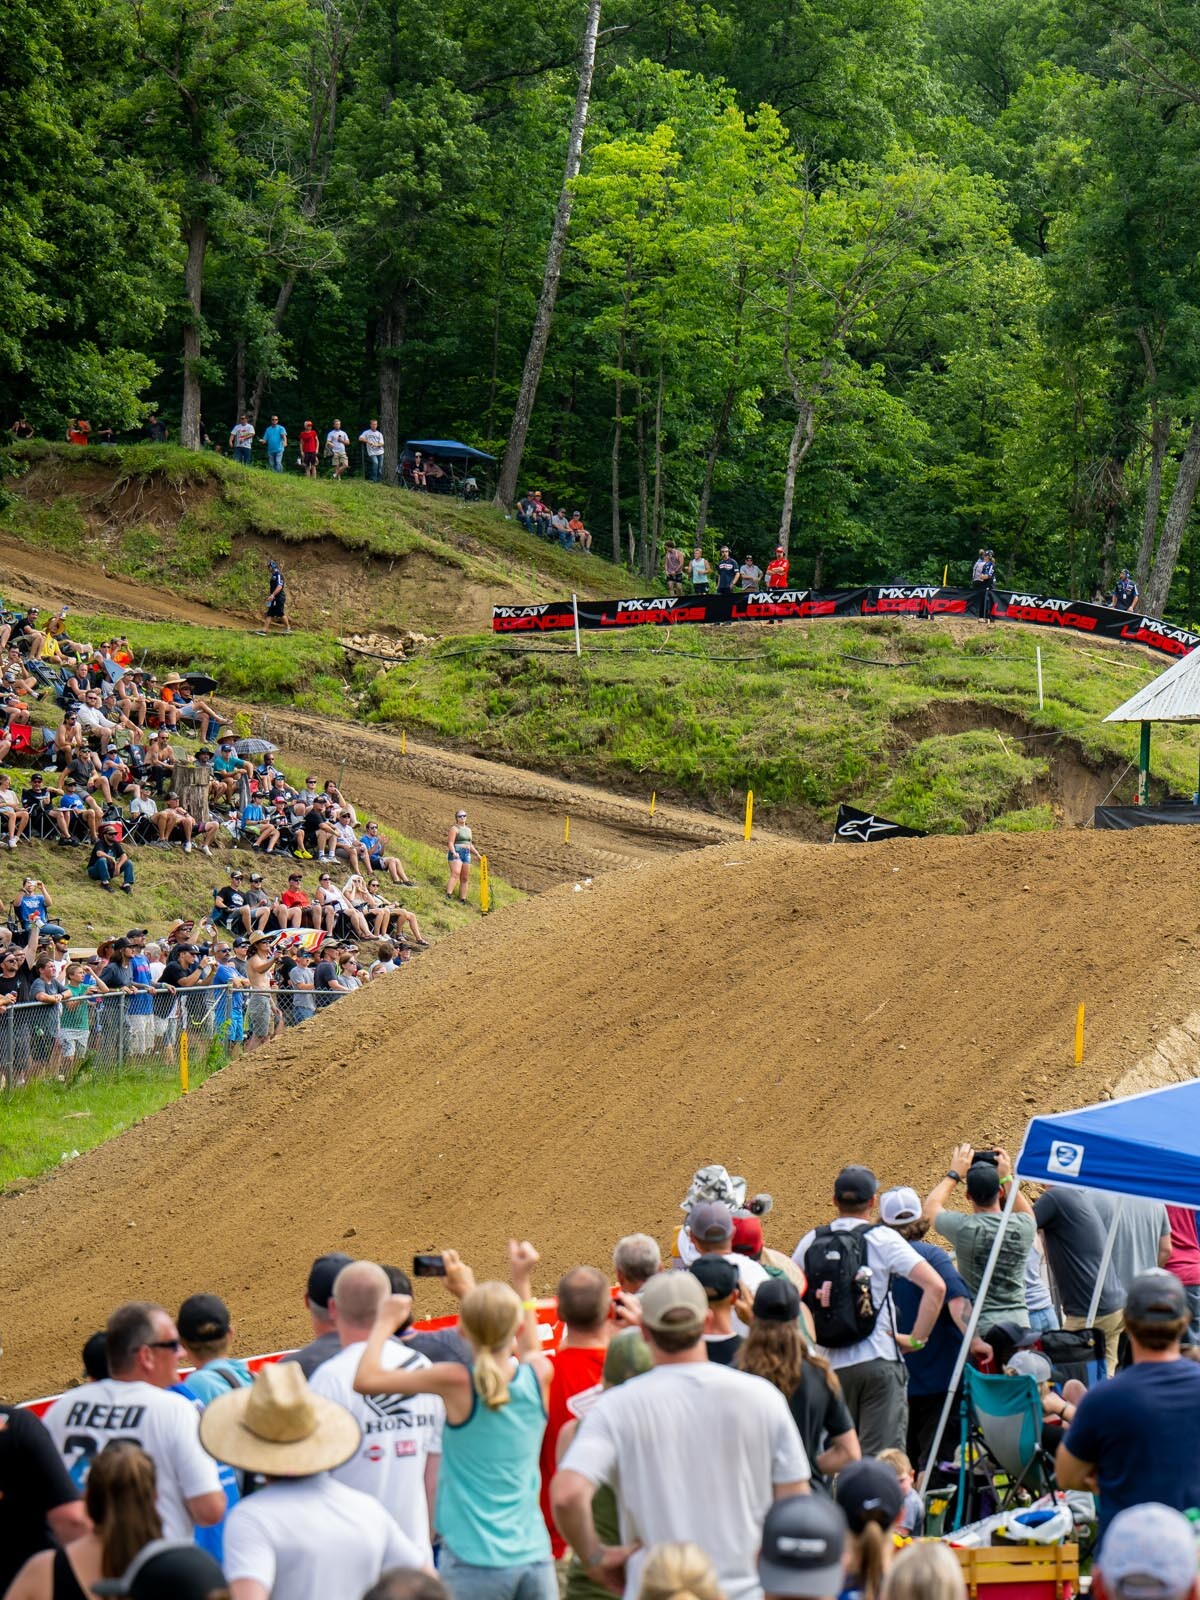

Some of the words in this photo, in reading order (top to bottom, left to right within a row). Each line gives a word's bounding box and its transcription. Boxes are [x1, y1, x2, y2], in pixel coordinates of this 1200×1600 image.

[747, 593, 773, 604] MX
[777, 591, 809, 603] ATV
[878, 588, 906, 599] MX
[909, 587, 941, 598] ATV
[493, 606, 517, 618] MX
[520, 604, 550, 617] ATV
[618, 599, 643, 612] MX
[648, 598, 679, 610] ATV
[1009, 594, 1037, 607] MX
[1039, 599, 1073, 611] ATV
[493, 614, 575, 631] EGENDS
[990, 602, 1098, 631] LEGENDS
[1140, 617, 1165, 634] MX
[1167, 629, 1200, 644] ATV
[1120, 625, 1195, 657] LEGEN
[65, 1401, 147, 1430] REED
